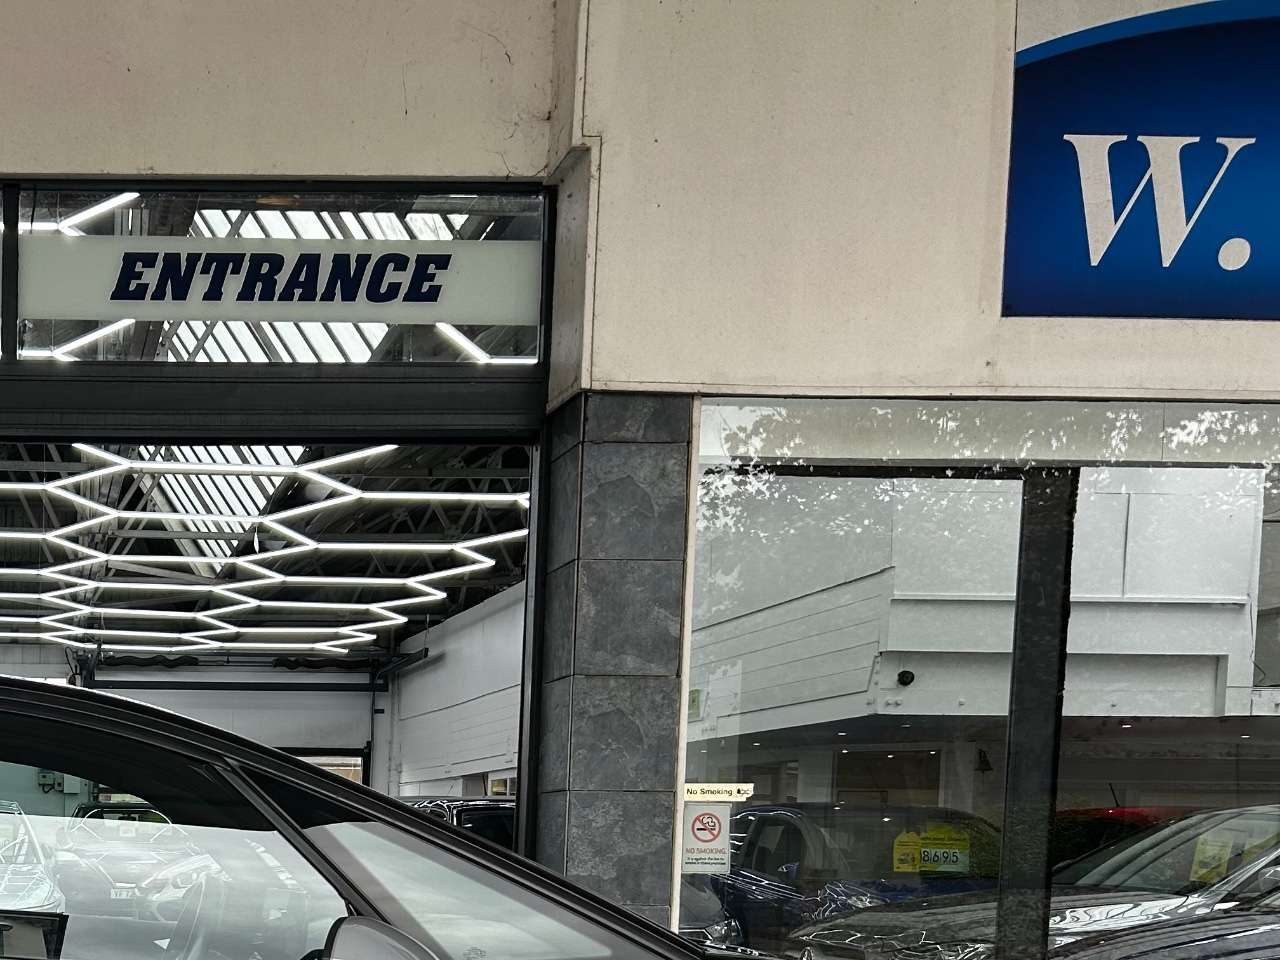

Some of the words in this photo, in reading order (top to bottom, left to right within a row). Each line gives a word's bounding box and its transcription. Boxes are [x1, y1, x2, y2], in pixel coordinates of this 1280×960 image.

[1063, 134, 1257, 271] W.
[110, 252, 452, 303] ENTRANCE
[700, 788, 733, 796] Smoking
[922, 850, 959, 864] 8695
